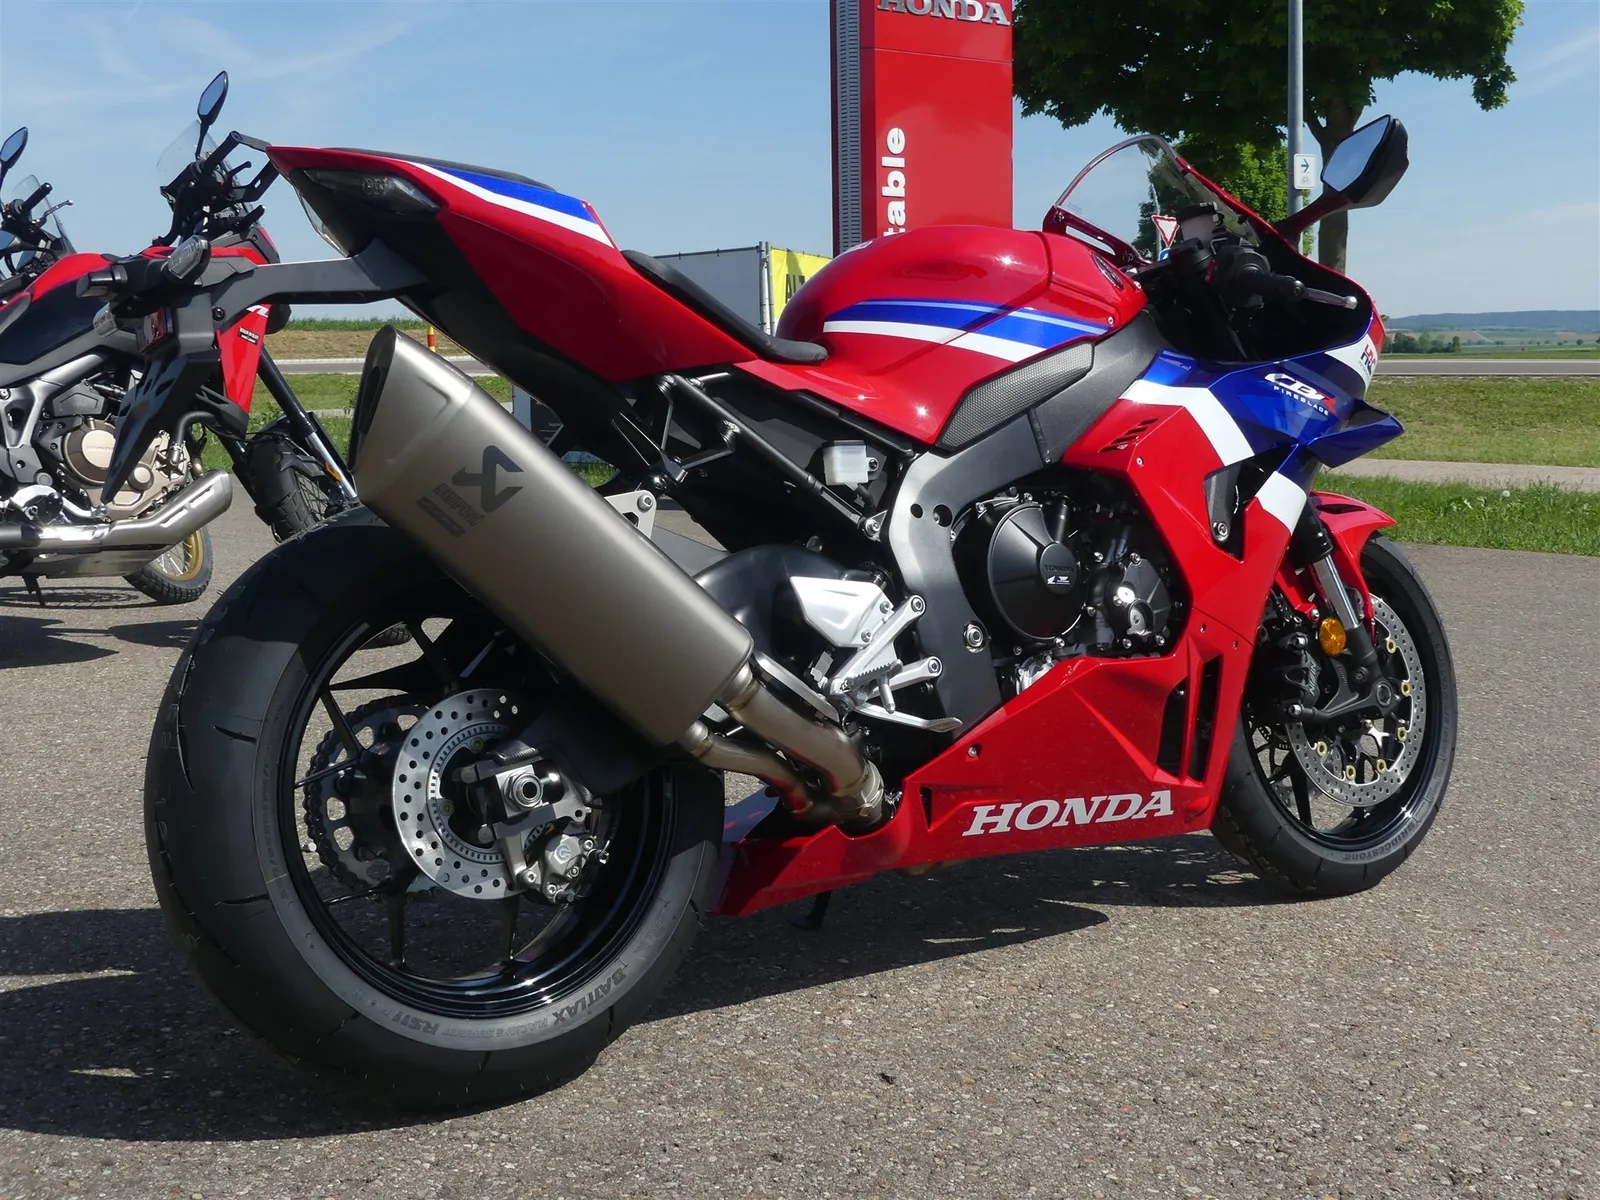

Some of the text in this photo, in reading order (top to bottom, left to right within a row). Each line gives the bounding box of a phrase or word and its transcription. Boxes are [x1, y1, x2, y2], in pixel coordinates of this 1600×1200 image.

[877, 0, 1011, 25] HONDA
[1273, 385, 1330, 416] FIREBLADE
[962, 789, 1174, 836] HONDA
